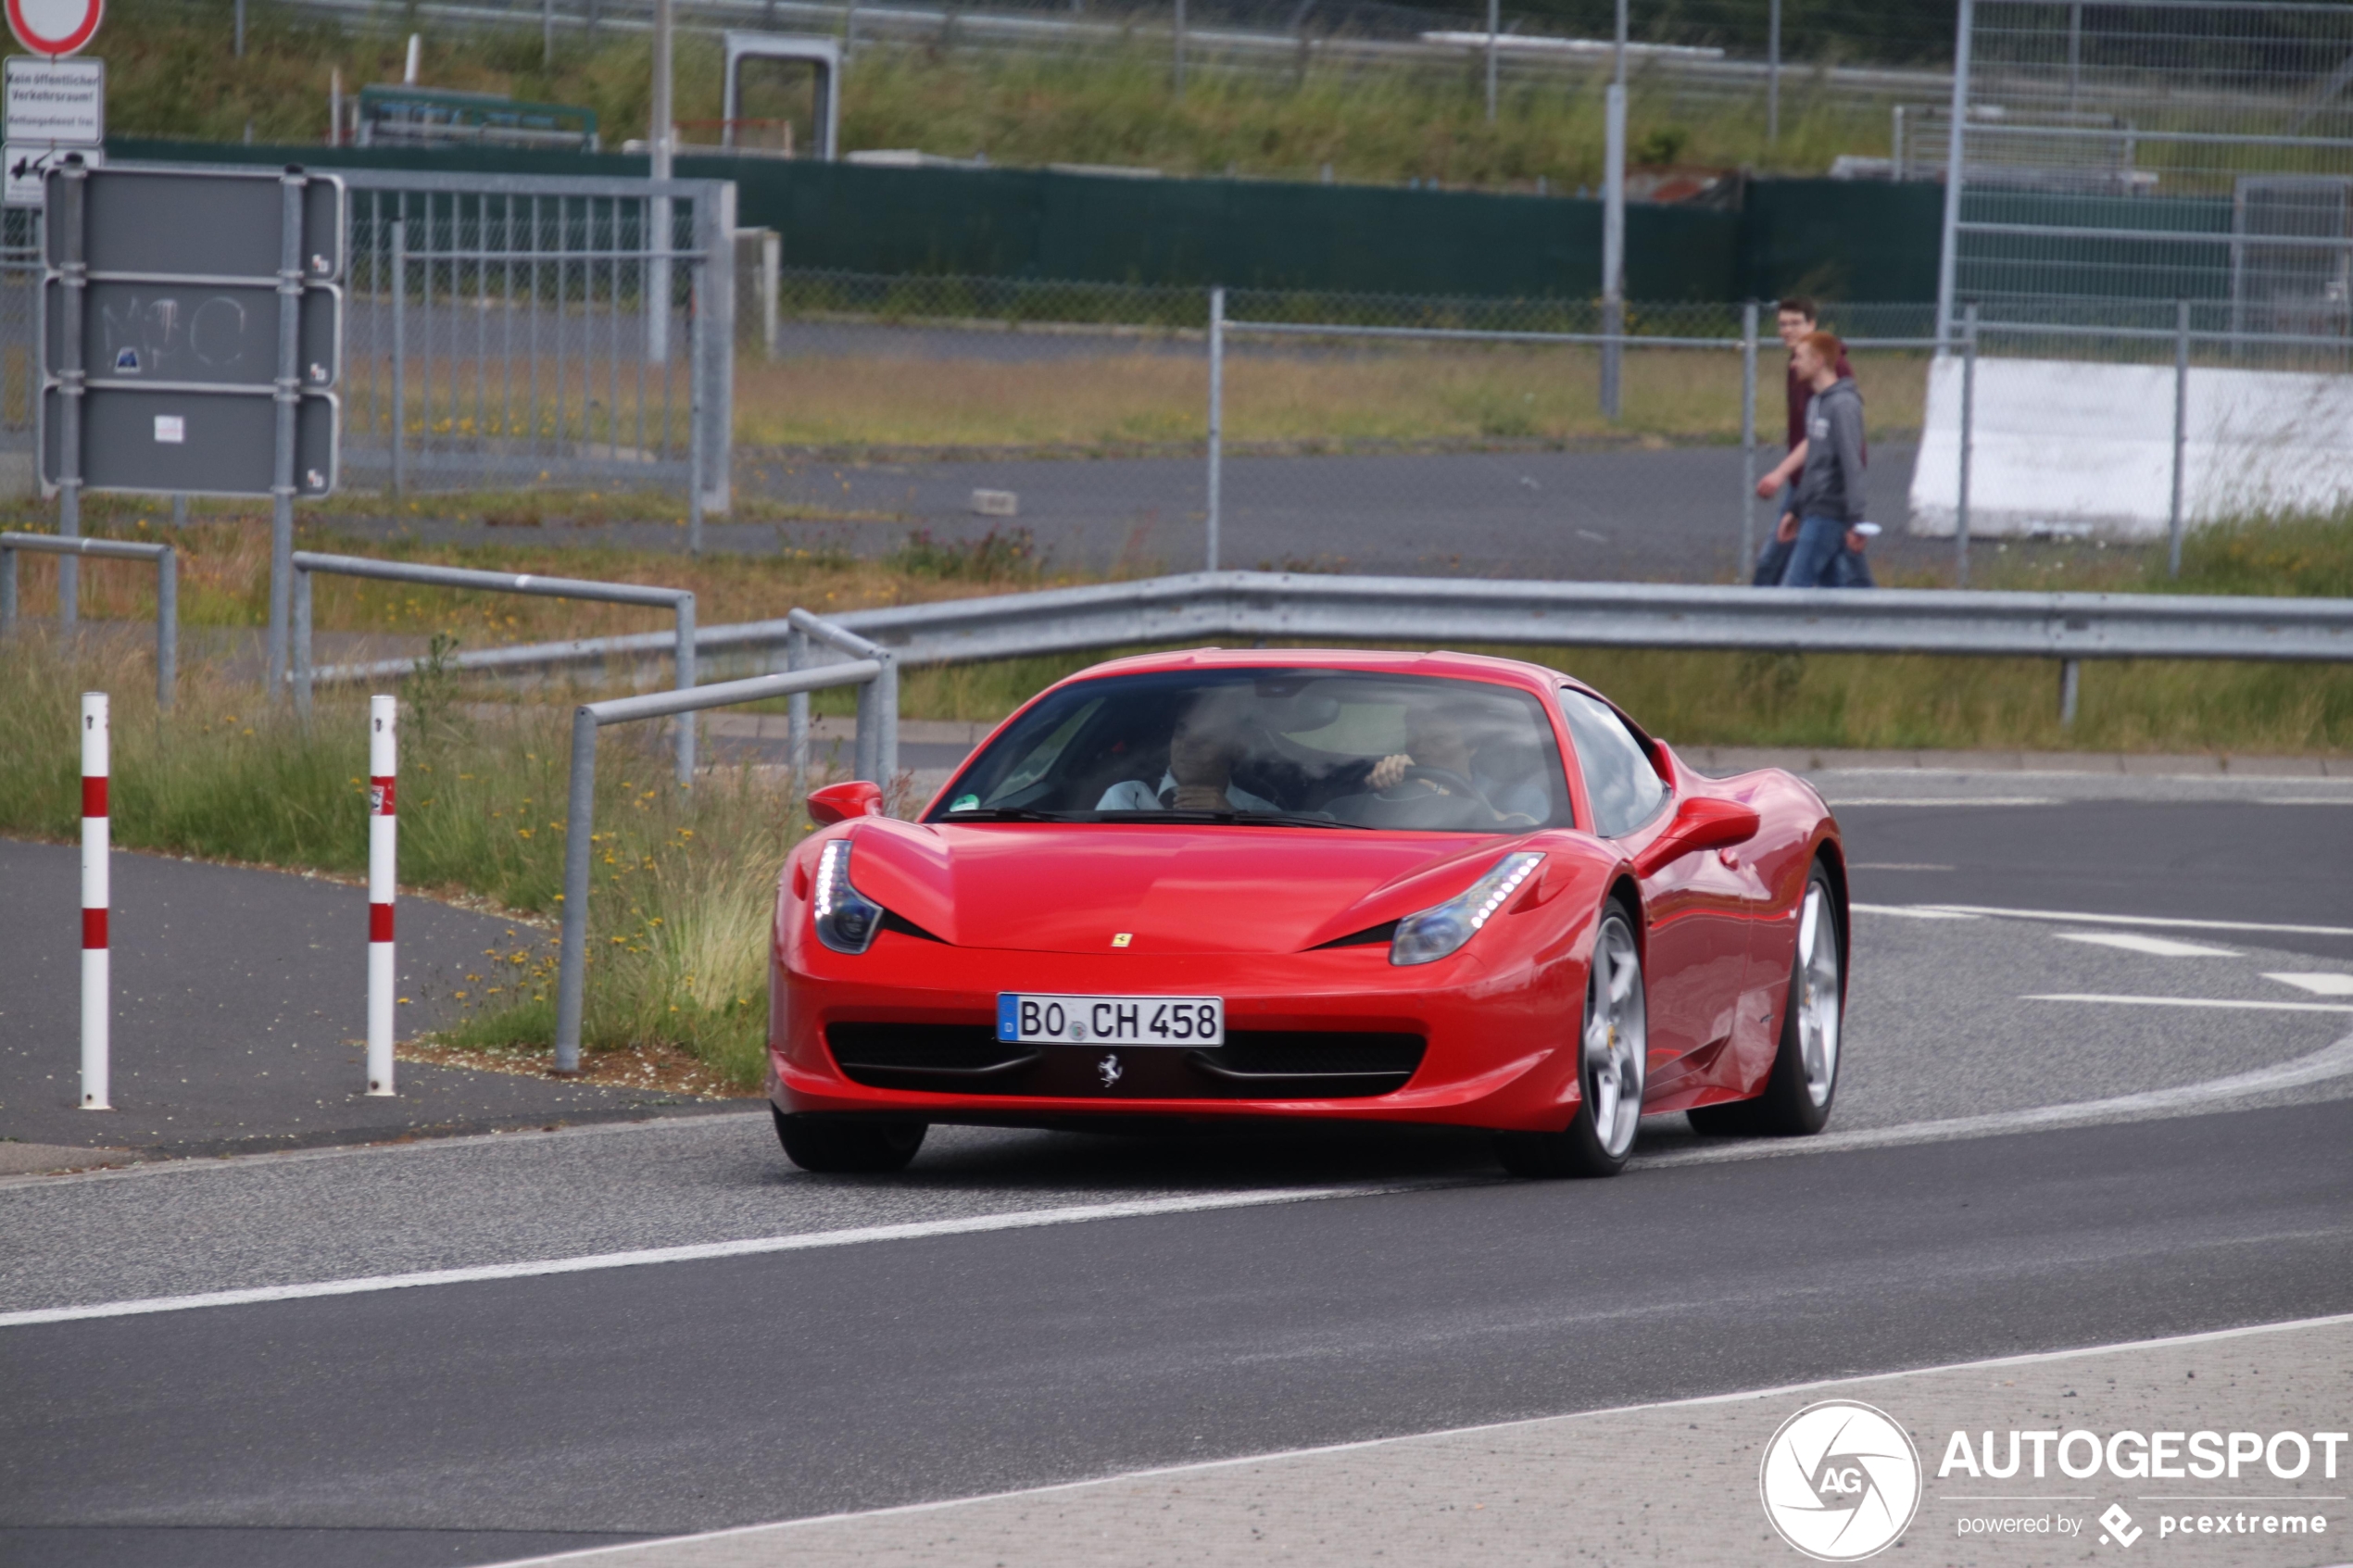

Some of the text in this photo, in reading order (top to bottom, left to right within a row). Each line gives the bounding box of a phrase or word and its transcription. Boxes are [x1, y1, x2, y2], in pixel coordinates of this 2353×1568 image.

[1004, 1022, 1014, 1033] D
[1021, 1001, 1216, 1039] BO CH 458
